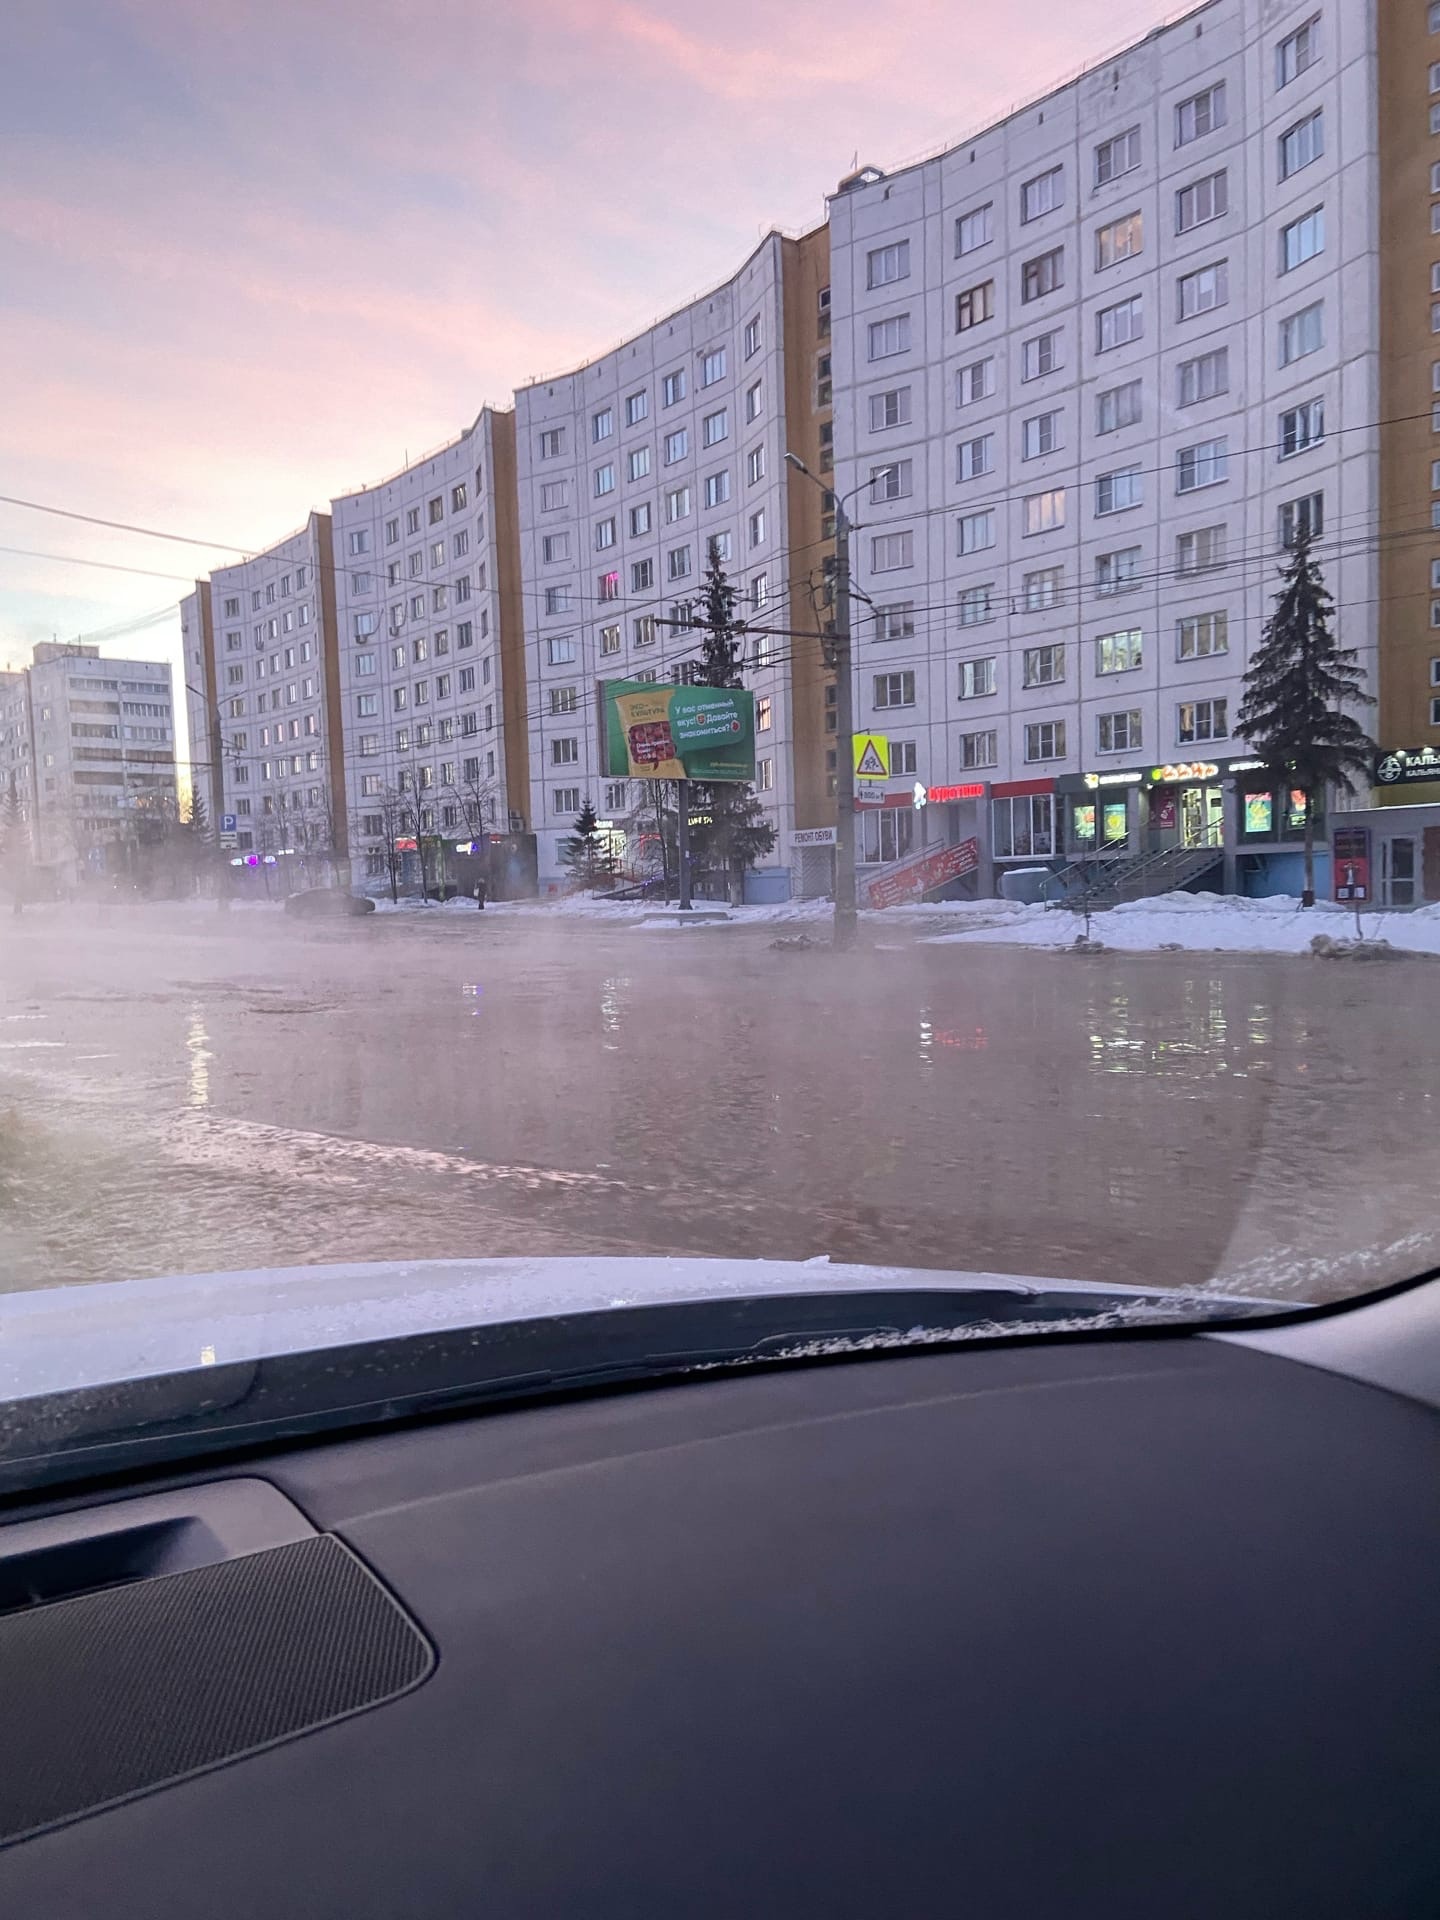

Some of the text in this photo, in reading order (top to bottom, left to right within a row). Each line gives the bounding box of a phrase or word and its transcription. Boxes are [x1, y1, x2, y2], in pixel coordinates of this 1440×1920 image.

[674, 705, 681, 714] У
[707, 711, 738, 724] Давайте
[1406, 754, 1440, 767] КАЛЬ
[794, 829, 833, 843] РЕМОНТ ОБУВИ
